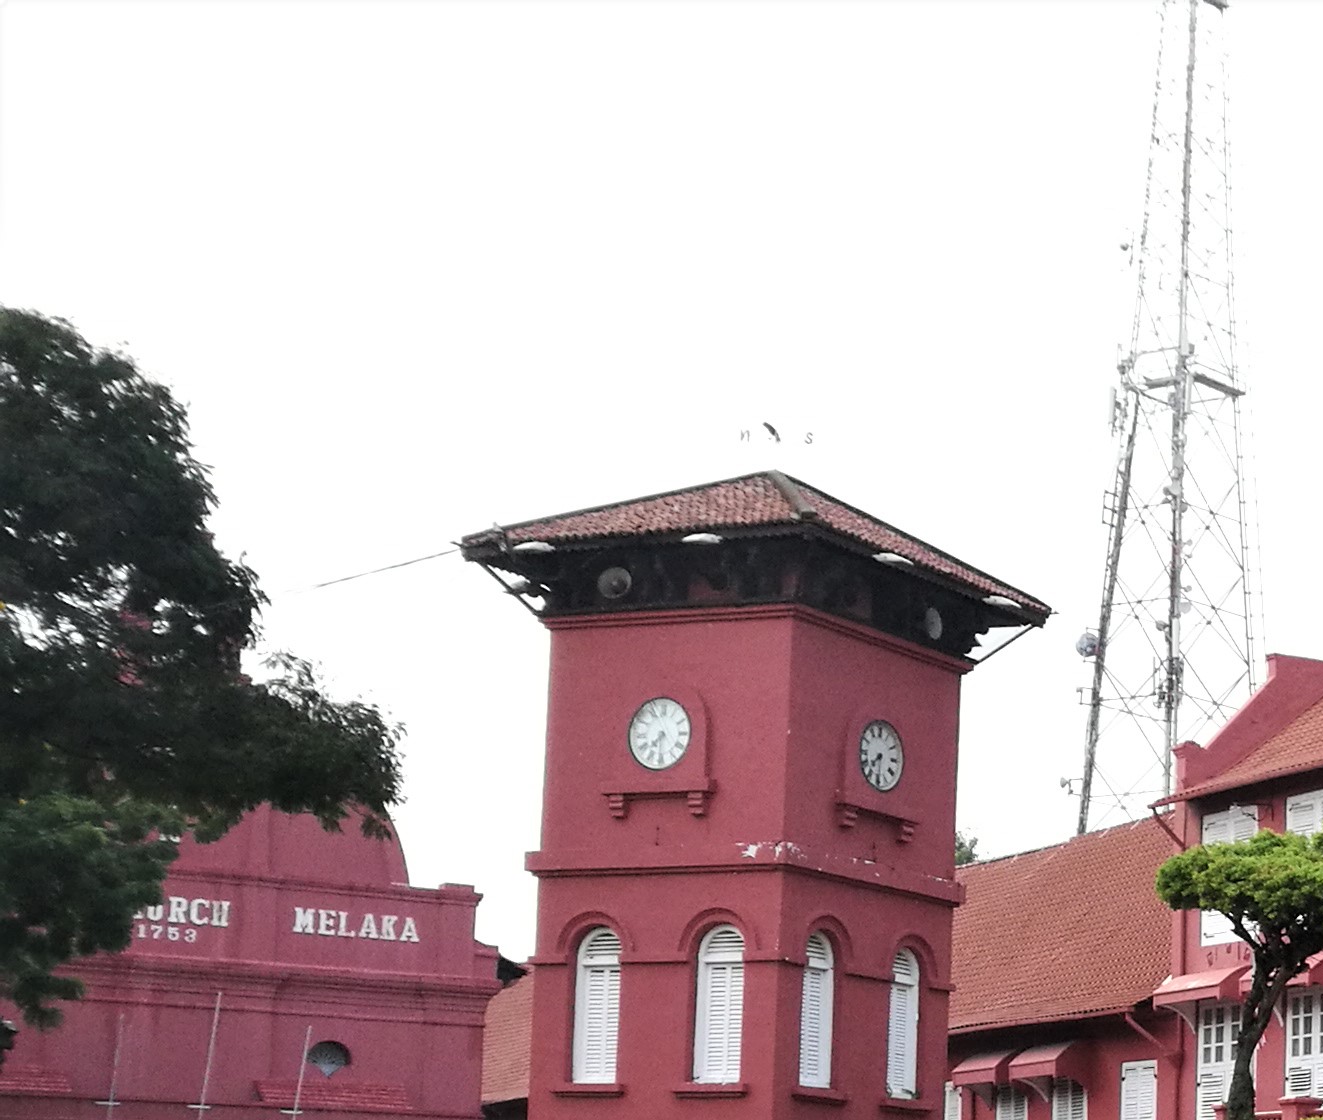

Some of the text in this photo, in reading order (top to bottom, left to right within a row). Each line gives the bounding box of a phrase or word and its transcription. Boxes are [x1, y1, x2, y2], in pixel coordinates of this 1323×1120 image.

[133, 896, 420, 942] URCH MELAKA
[137, 924, 197, 943] 1753
